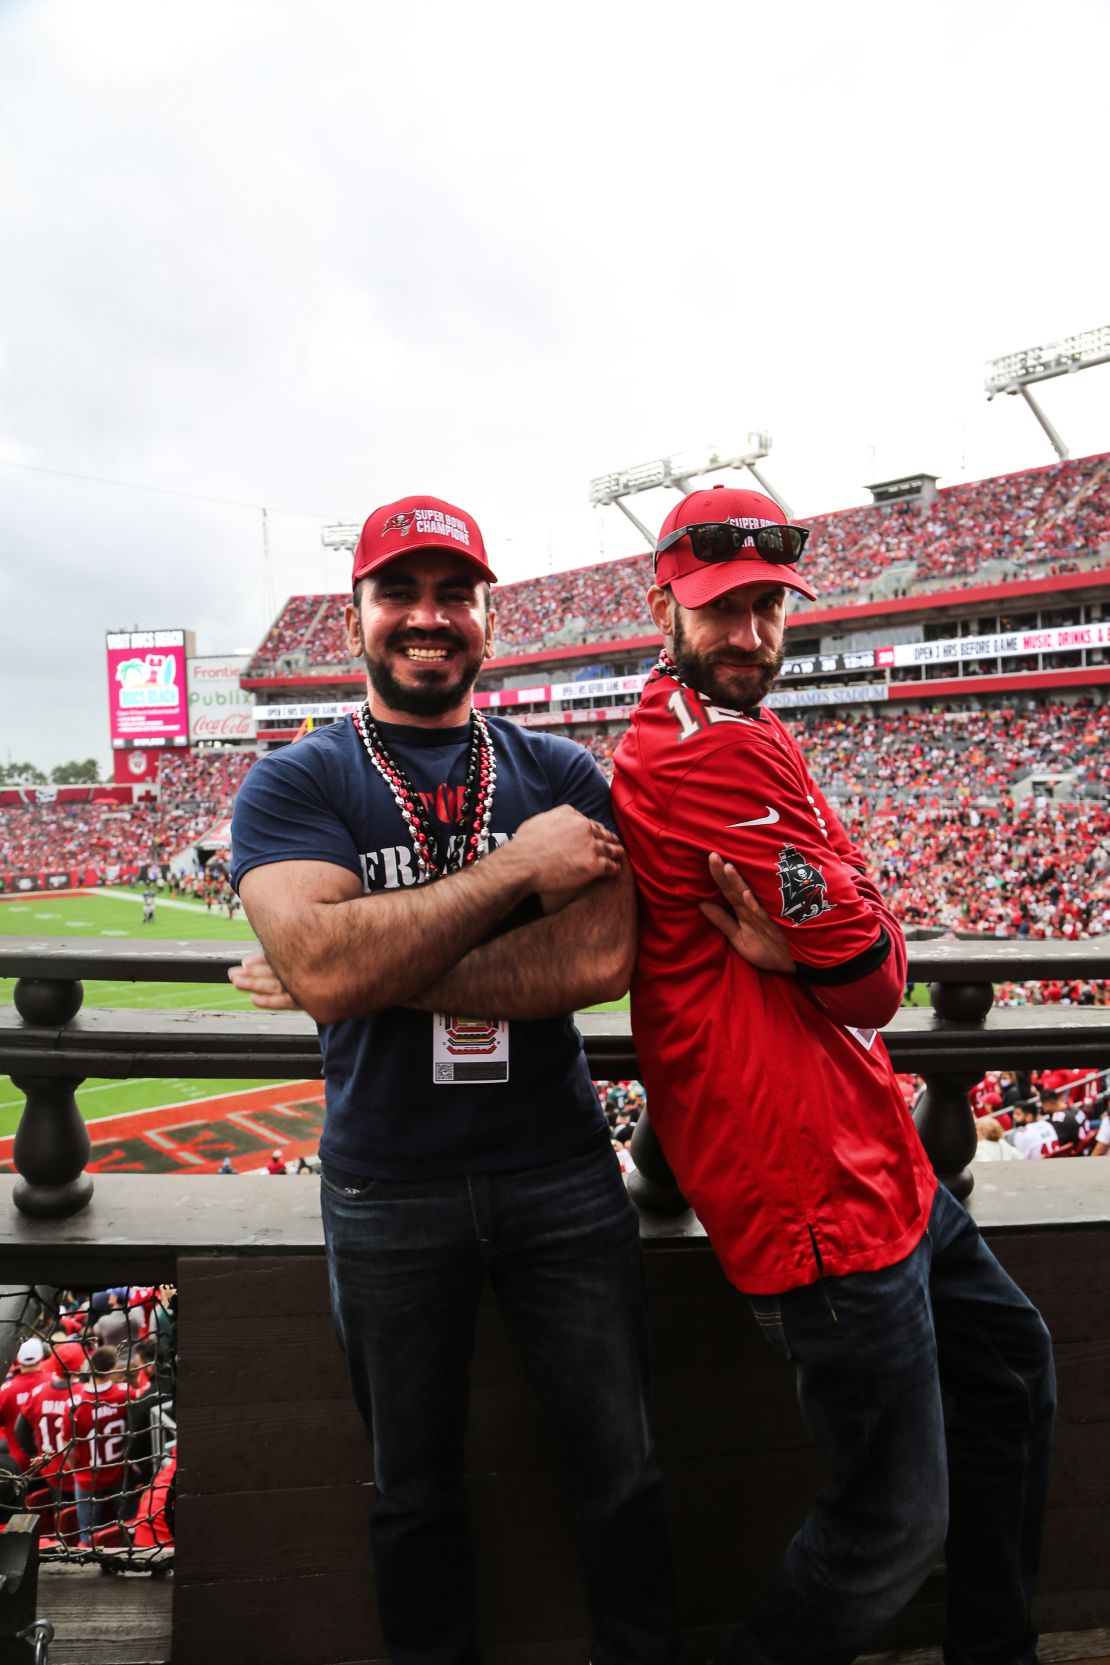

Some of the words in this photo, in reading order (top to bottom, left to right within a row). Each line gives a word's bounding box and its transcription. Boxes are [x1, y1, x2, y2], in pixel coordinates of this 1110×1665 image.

[415, 509, 445, 524] SUPER
[445, 514, 469, 534] BOWL
[416, 520, 470, 546] CHAMPIONS
[914, 645, 933, 661] OPEN
[943, 643, 957, 658] HRS
[960, 640, 990, 657] BEFORE
[993, 637, 1019, 654] GAME
[189, 689, 251, 707] Publix
[792, 691, 830, 706] JAMES
[833, 686, 886, 703] STADIUM
